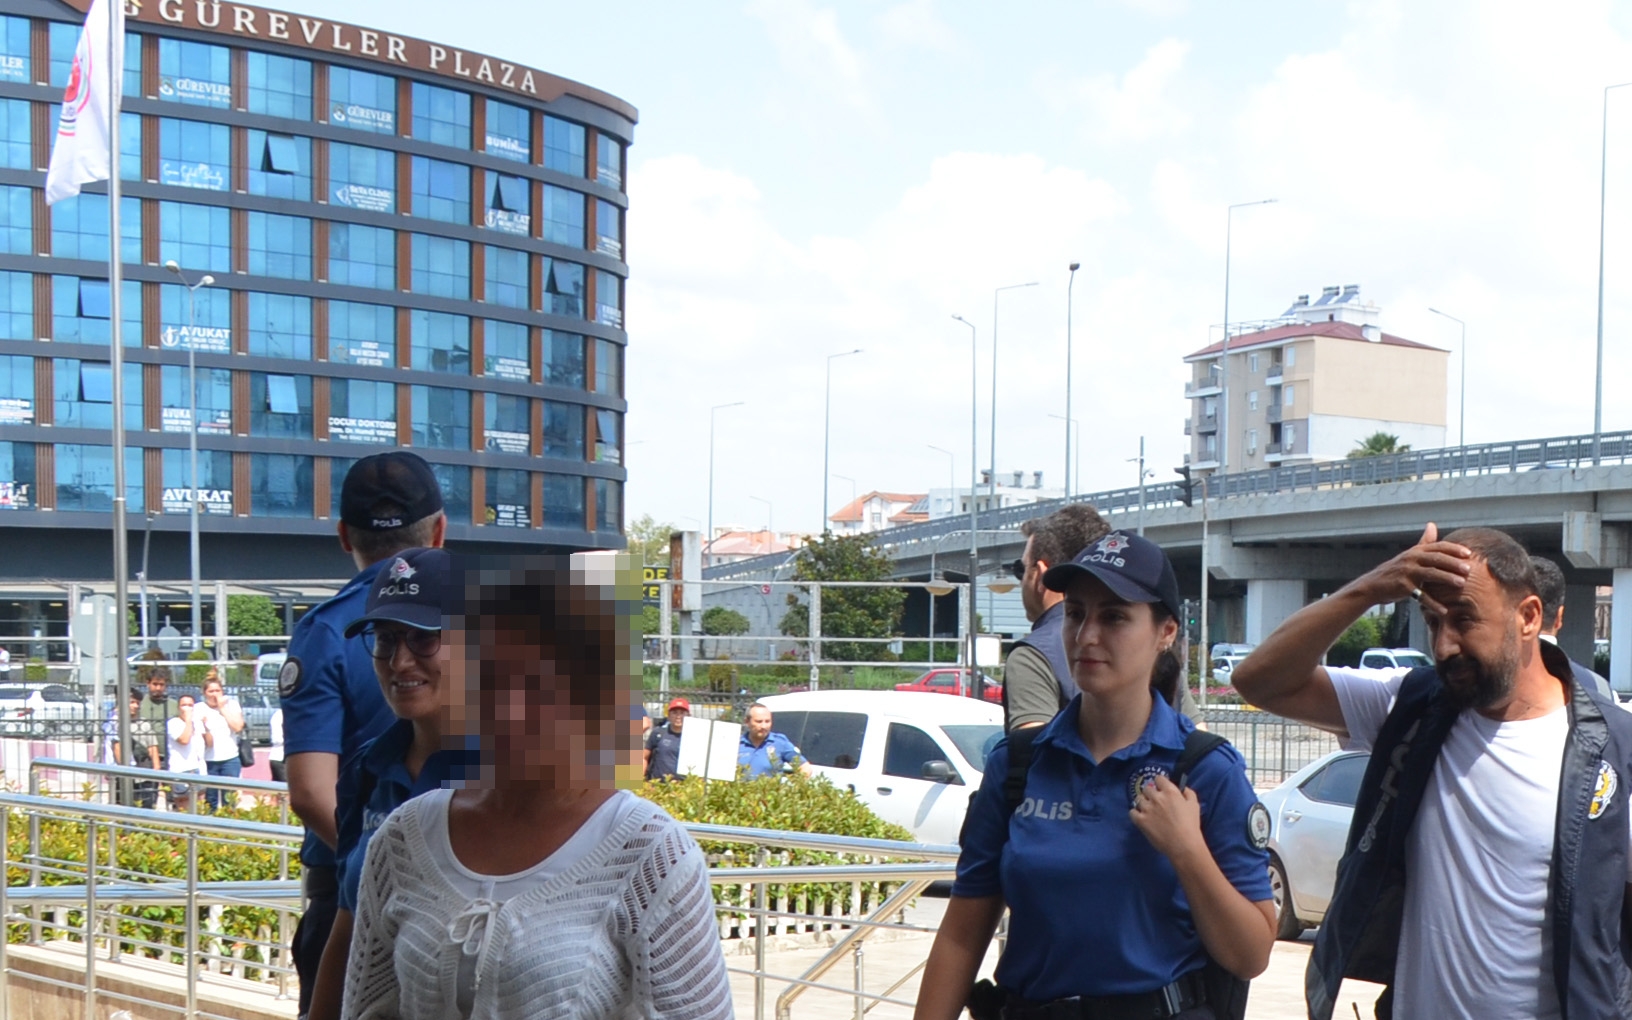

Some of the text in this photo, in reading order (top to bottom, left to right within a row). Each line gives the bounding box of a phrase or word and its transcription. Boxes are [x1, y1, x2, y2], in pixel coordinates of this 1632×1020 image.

[158, 0, 537, 94] GÜREVLER PLAZA
[162, 488, 232, 503] AVUKAT
